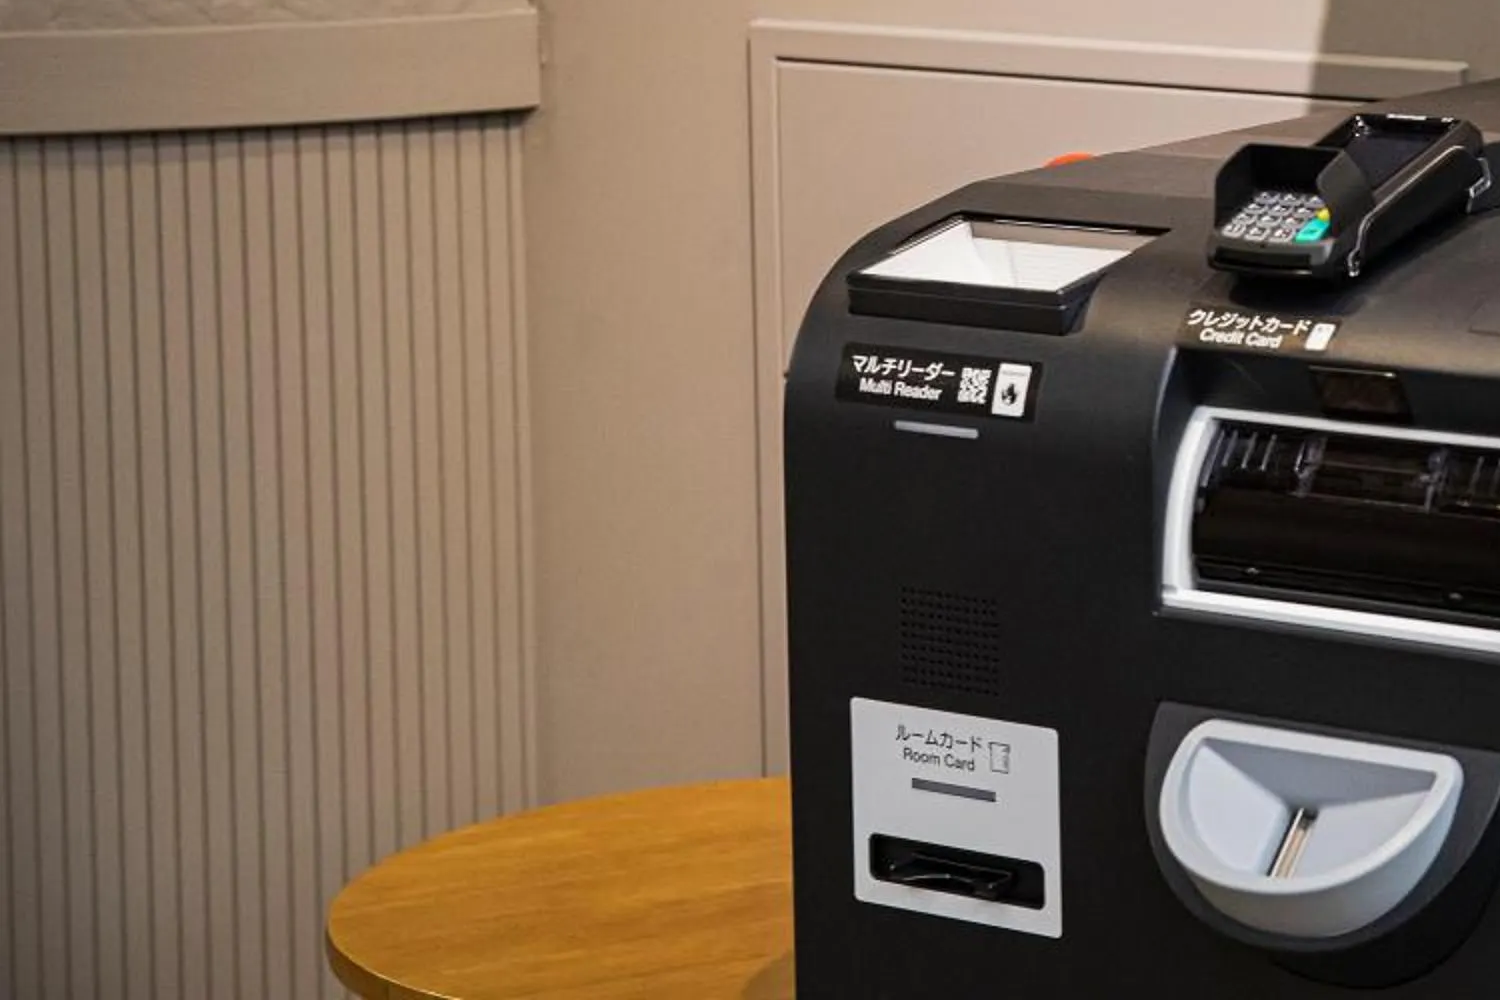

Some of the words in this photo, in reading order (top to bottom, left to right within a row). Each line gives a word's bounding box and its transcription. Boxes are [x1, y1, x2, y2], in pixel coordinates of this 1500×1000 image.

[1187, 309, 1312, 336] クレジットカード
[1200, 328, 1244, 345] Credit
[1245, 331, 1283, 349] Card
[852, 354, 956, 381] マルチリーダー
[859, 377, 893, 394] Multi
[893, 381, 943, 400] Reader
[895, 724, 983, 753] ルームカード
[902, 747, 941, 767] Room
[943, 753, 975, 772] Card
